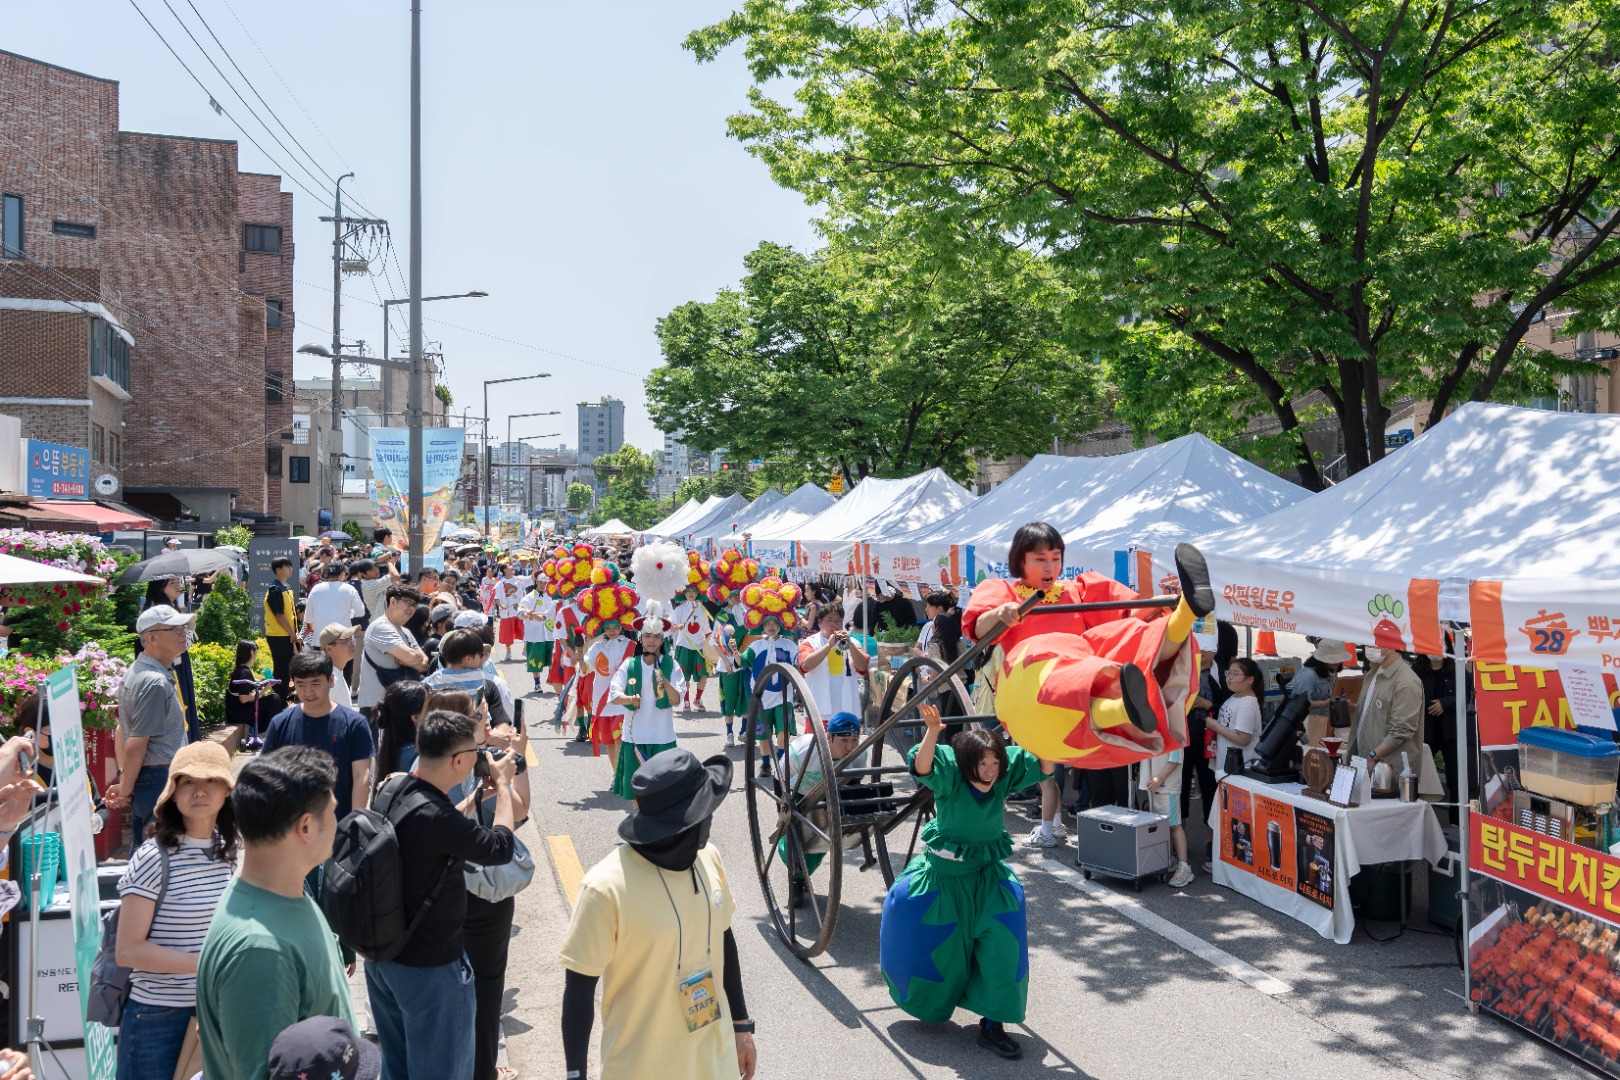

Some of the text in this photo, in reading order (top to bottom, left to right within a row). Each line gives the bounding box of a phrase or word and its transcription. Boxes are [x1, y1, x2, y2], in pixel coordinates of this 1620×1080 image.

[42, 449, 85, 479] 으뜸부동산
[1223, 583, 1296, 614] 위핑윌로우
[1232, 611, 1298, 632] Weeping willow
[1533, 629, 1566, 653] 28
[1258, 866, 1294, 888] 니트로 더치
[1299, 882, 1333, 908] 니트로 더치
[688, 996, 715, 1015] STAFF
